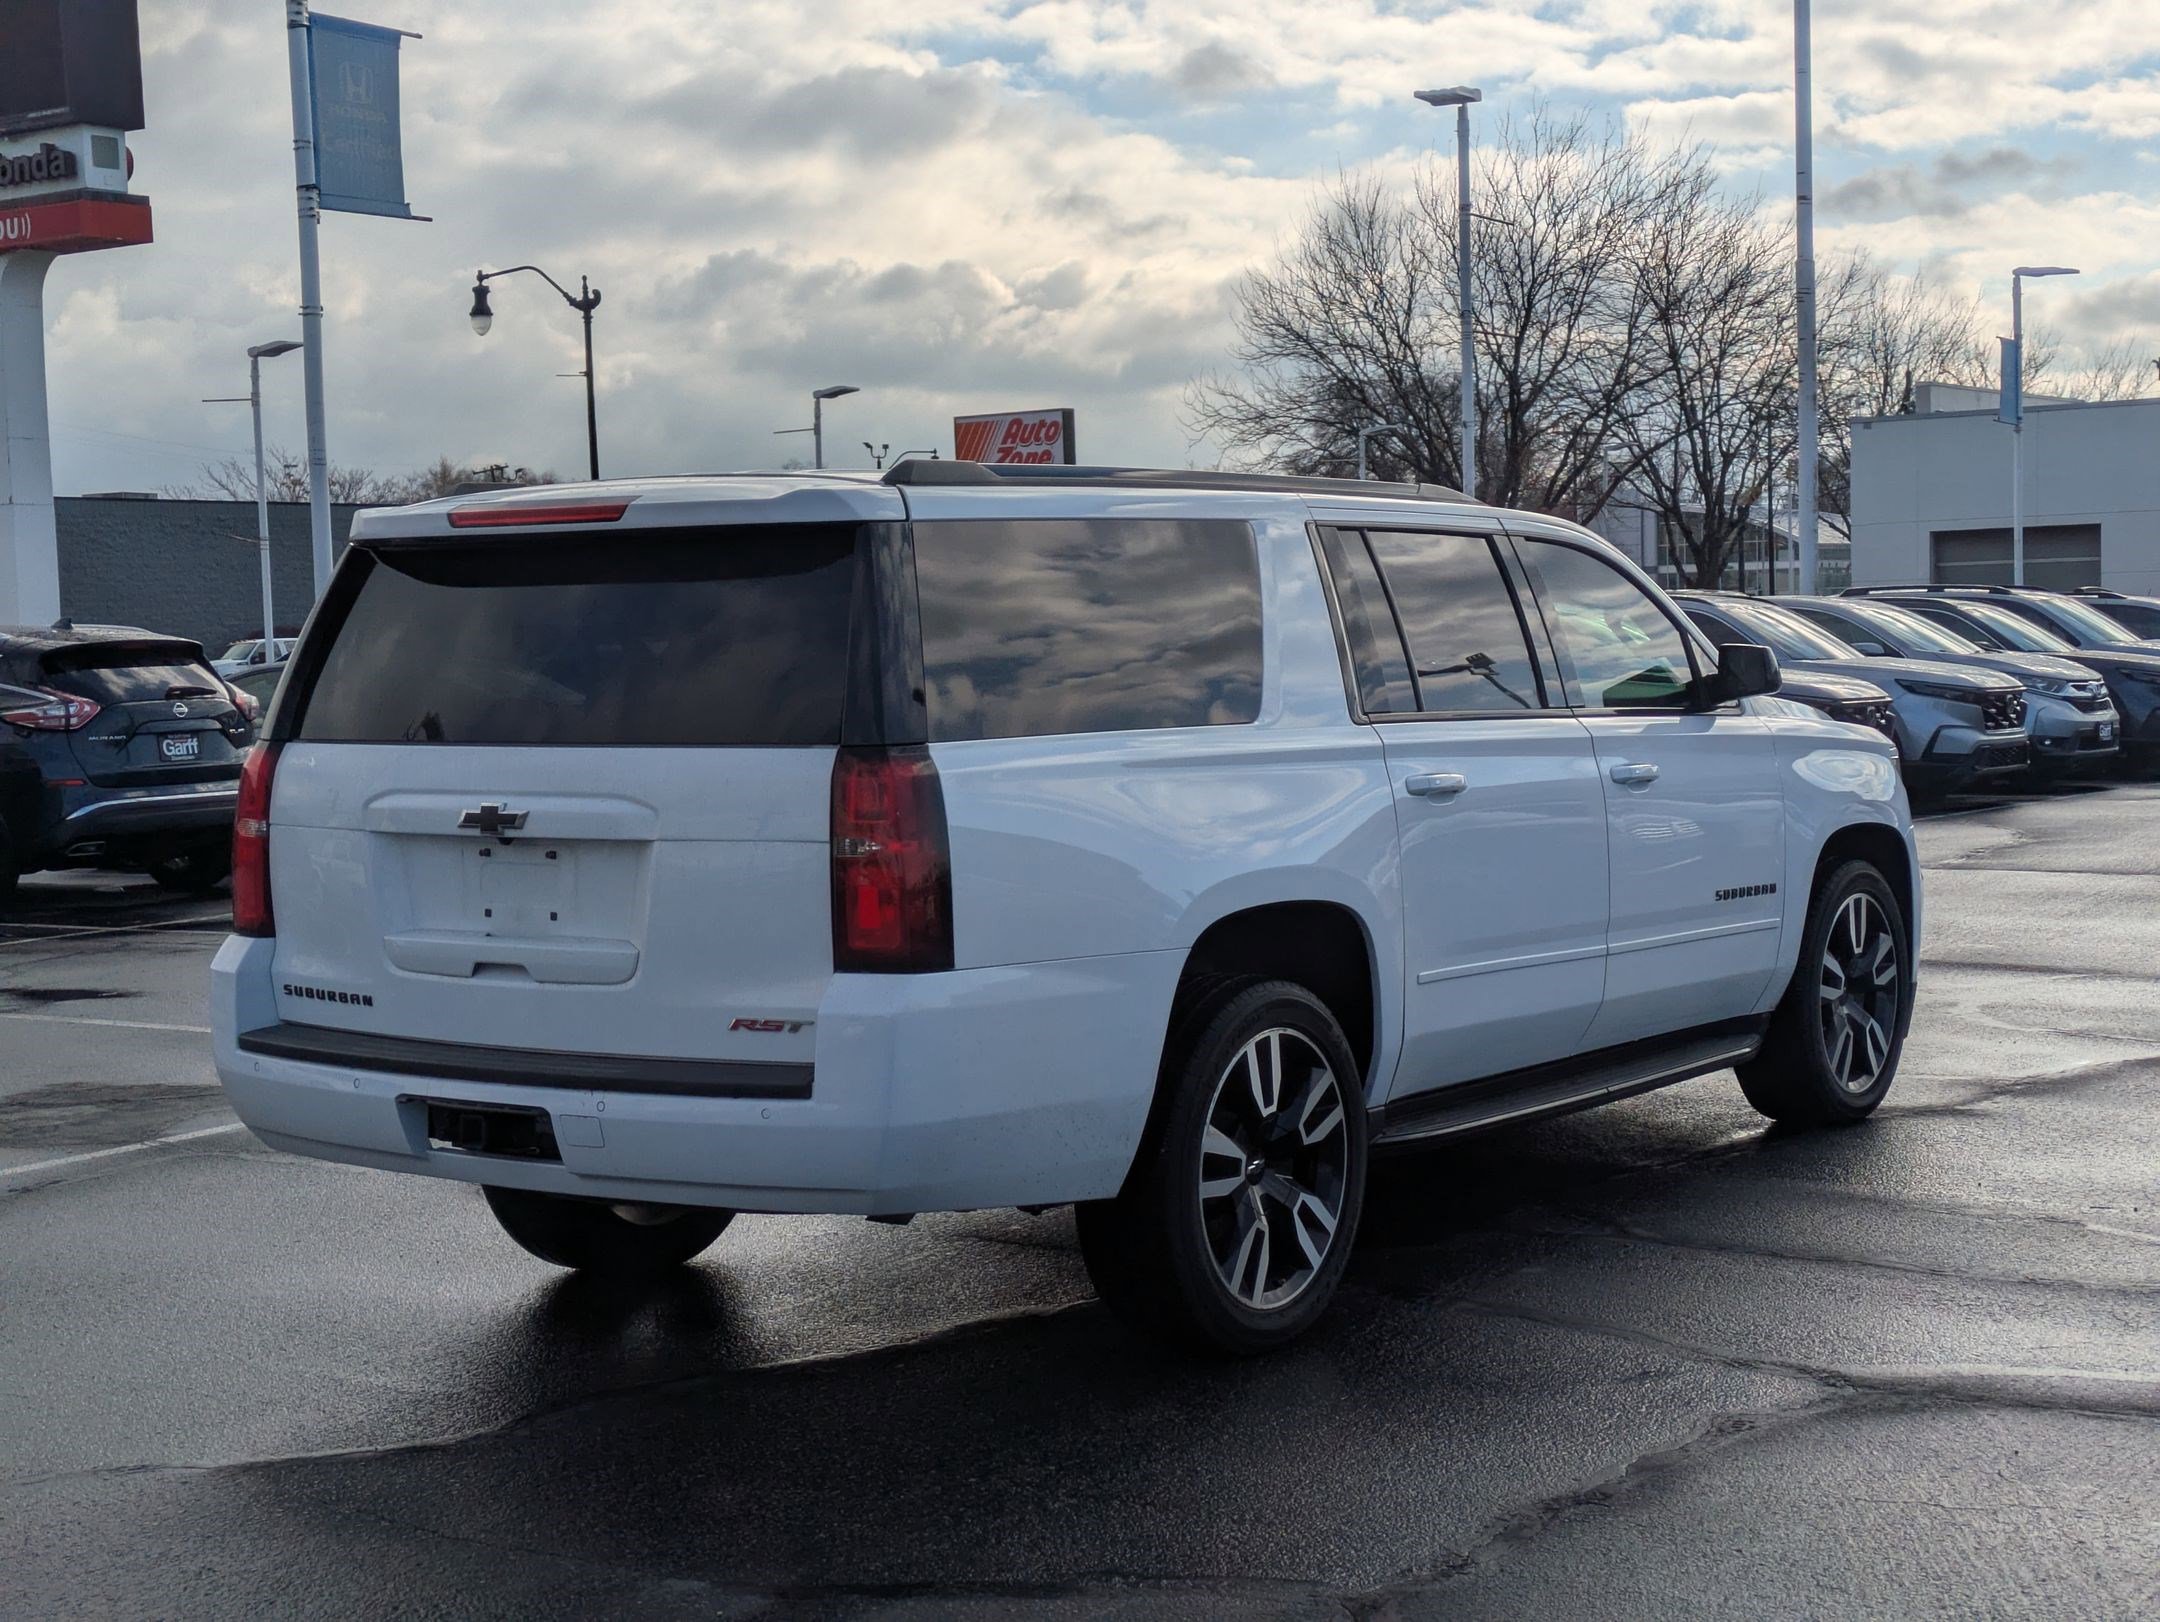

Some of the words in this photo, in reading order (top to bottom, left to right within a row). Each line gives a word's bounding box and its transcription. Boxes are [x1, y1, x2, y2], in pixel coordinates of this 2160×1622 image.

[1001, 417, 1061, 445] Auto
[163, 737, 199, 756] Garff
[1715, 882, 1777, 902] SUBURBAN
[283, 984, 373, 1007] SUBURBAN
[728, 1018, 815, 1034] RST
